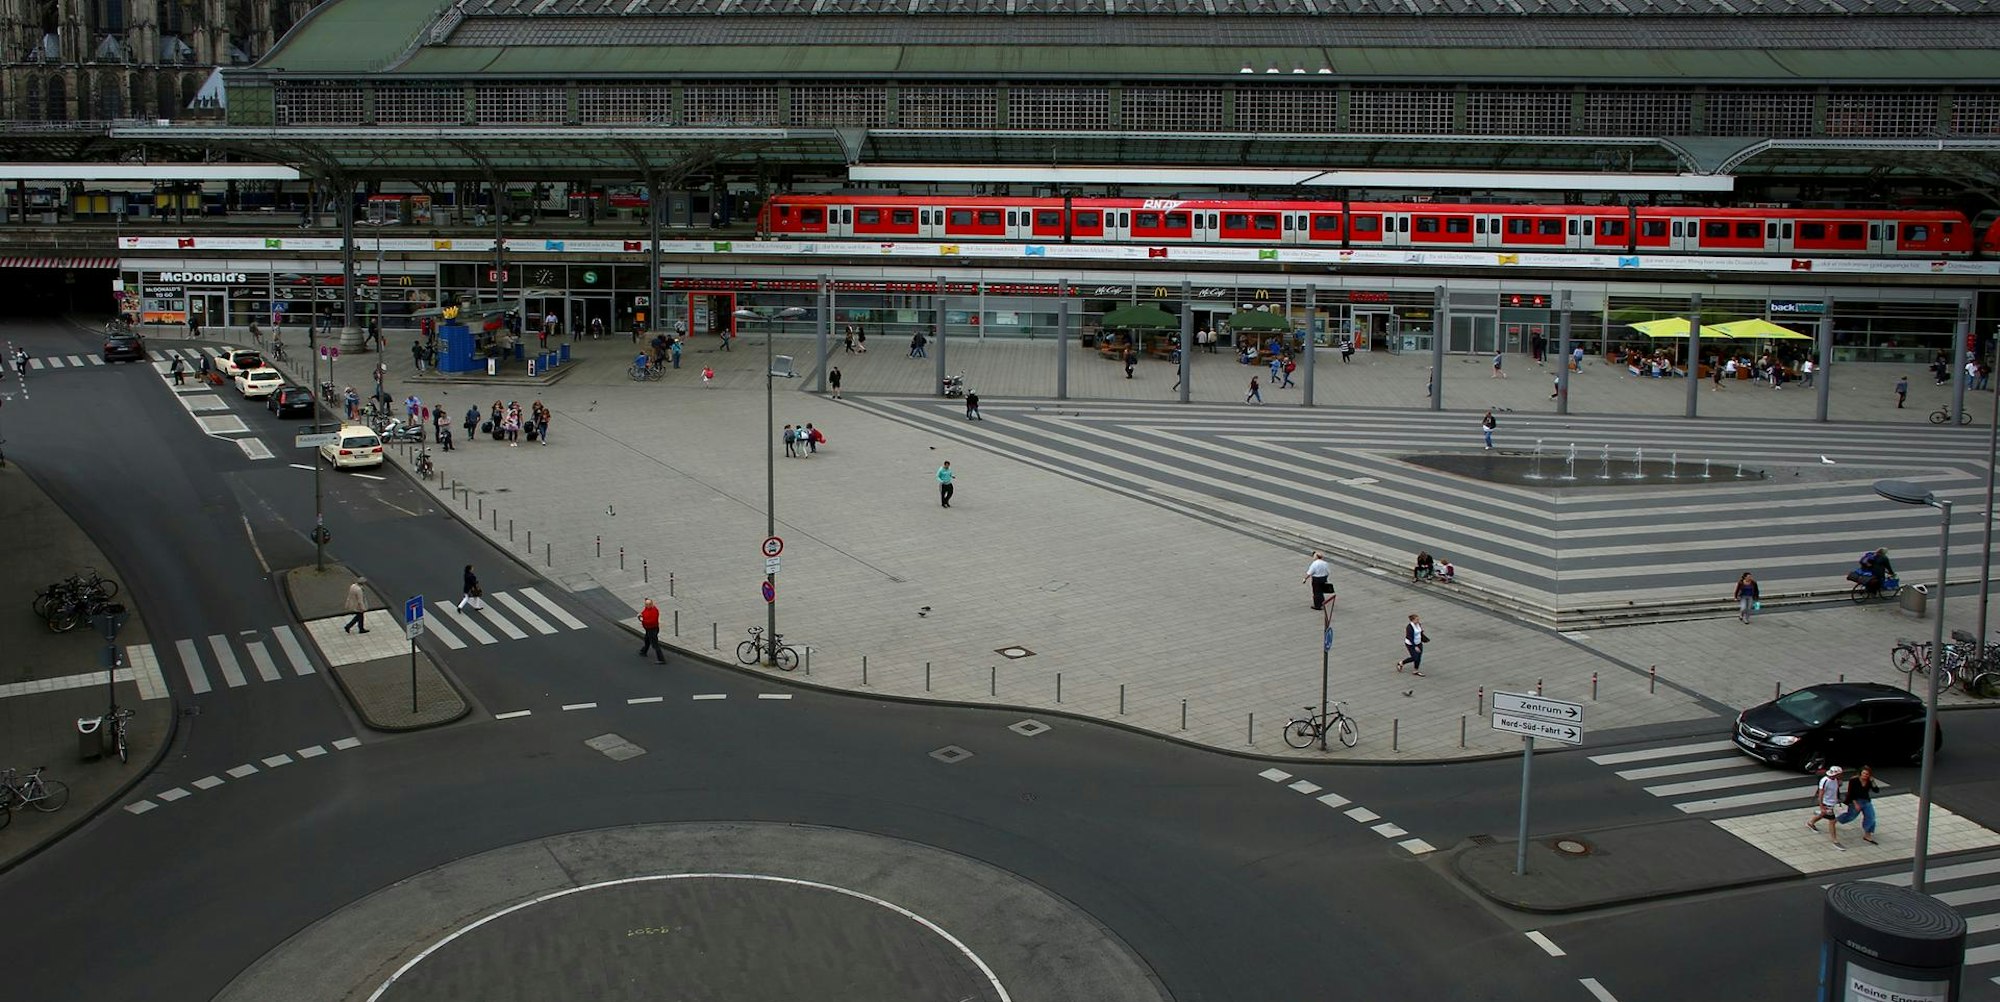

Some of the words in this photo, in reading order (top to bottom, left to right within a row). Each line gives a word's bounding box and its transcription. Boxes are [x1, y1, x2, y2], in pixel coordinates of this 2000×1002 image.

[160, 272, 246, 283] McDonald's
[766, 281, 882, 293] INTERNTIONAL
[1770, 303, 1795, 312] back
[1520, 701, 1562, 715] Zentrum
[1501, 718, 1561, 735] Nord-Süd-Fahrt
[1853, 982, 1888, 1000] Meine
